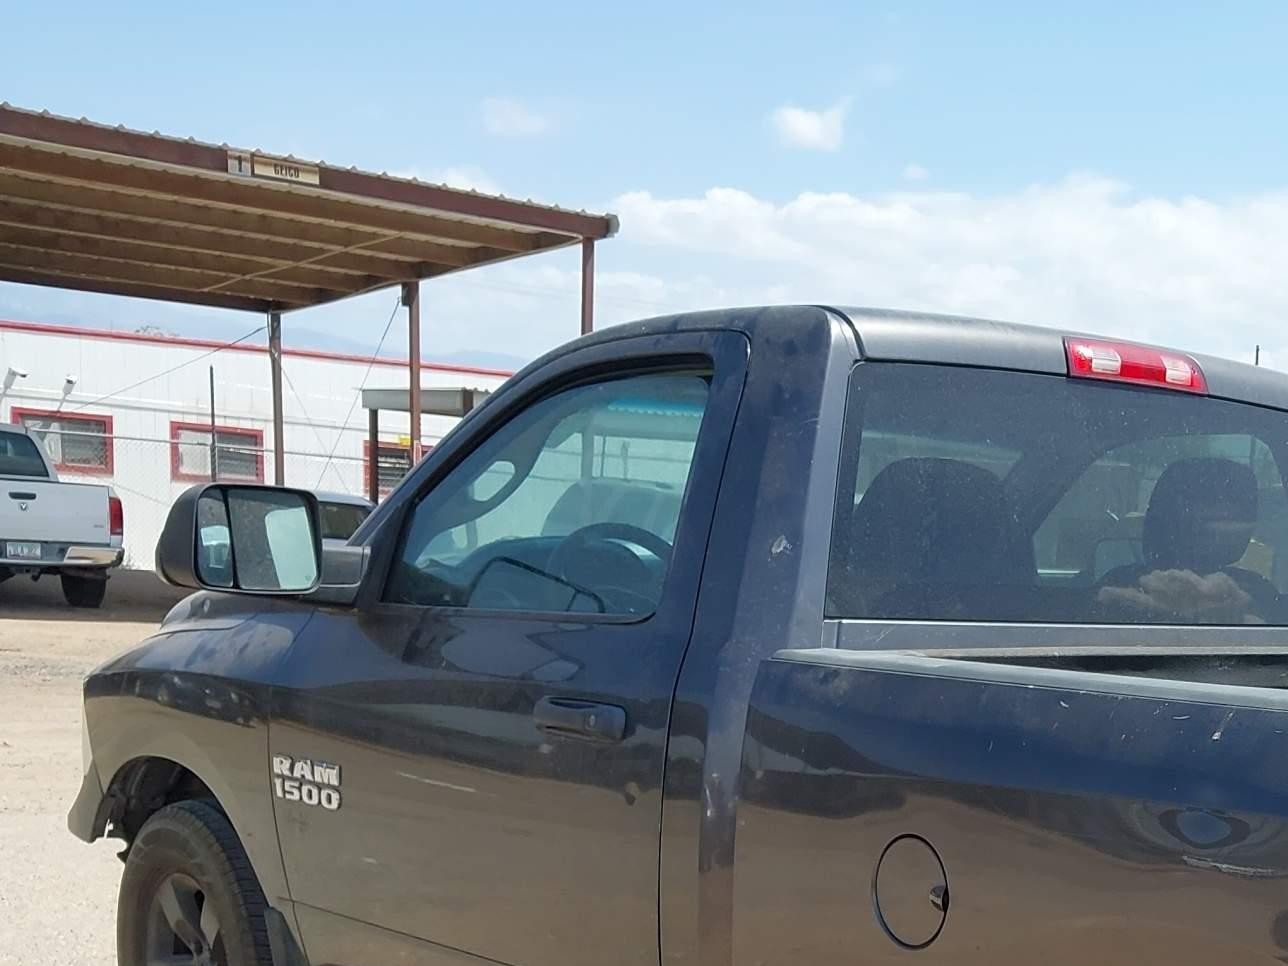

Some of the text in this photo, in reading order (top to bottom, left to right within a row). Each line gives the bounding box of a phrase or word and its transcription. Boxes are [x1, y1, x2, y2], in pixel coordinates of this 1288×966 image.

[273, 163, 300, 179] GEICO
[272, 755, 341, 787] RAM
[274, 777, 341, 811] 1500
